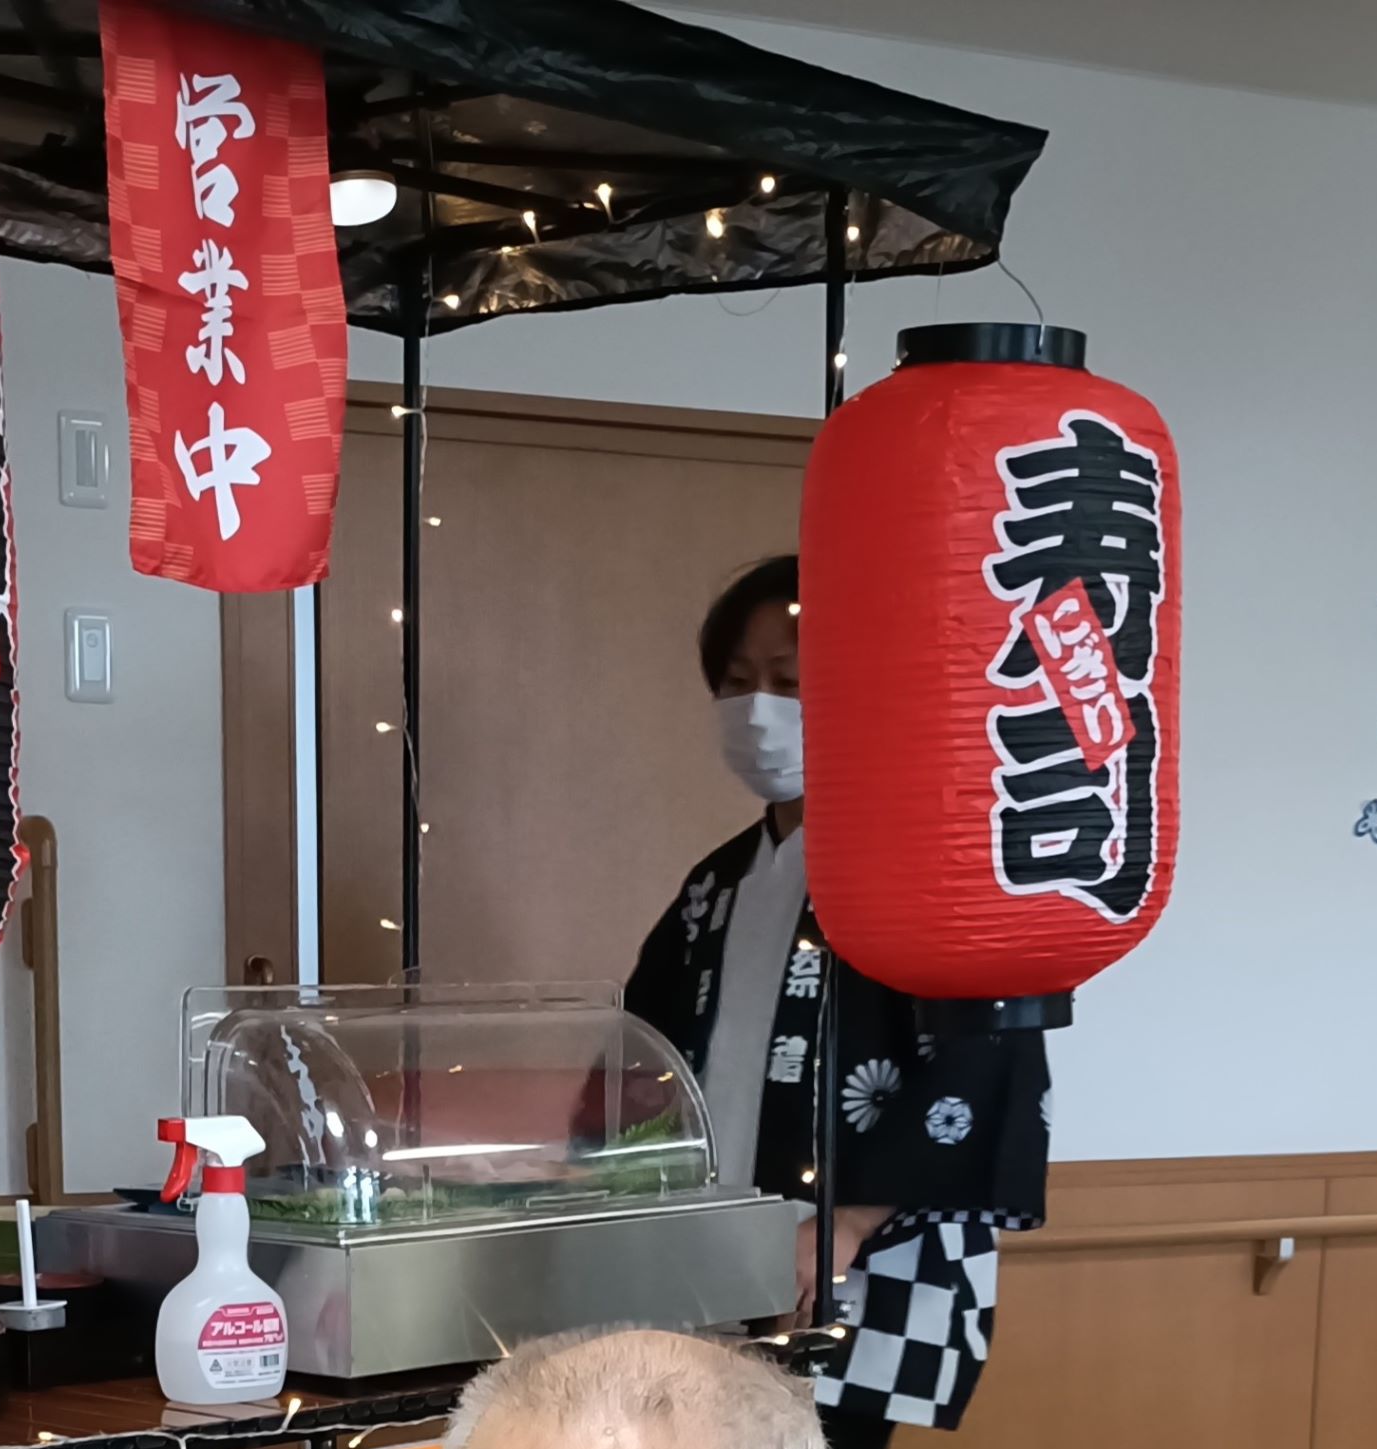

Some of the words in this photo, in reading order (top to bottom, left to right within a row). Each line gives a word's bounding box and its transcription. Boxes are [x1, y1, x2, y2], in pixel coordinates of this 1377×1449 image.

[174, 72, 272, 540] 営業中
[982, 409, 1164, 923] 寿司
[1034, 598, 1123, 747] にぎり
